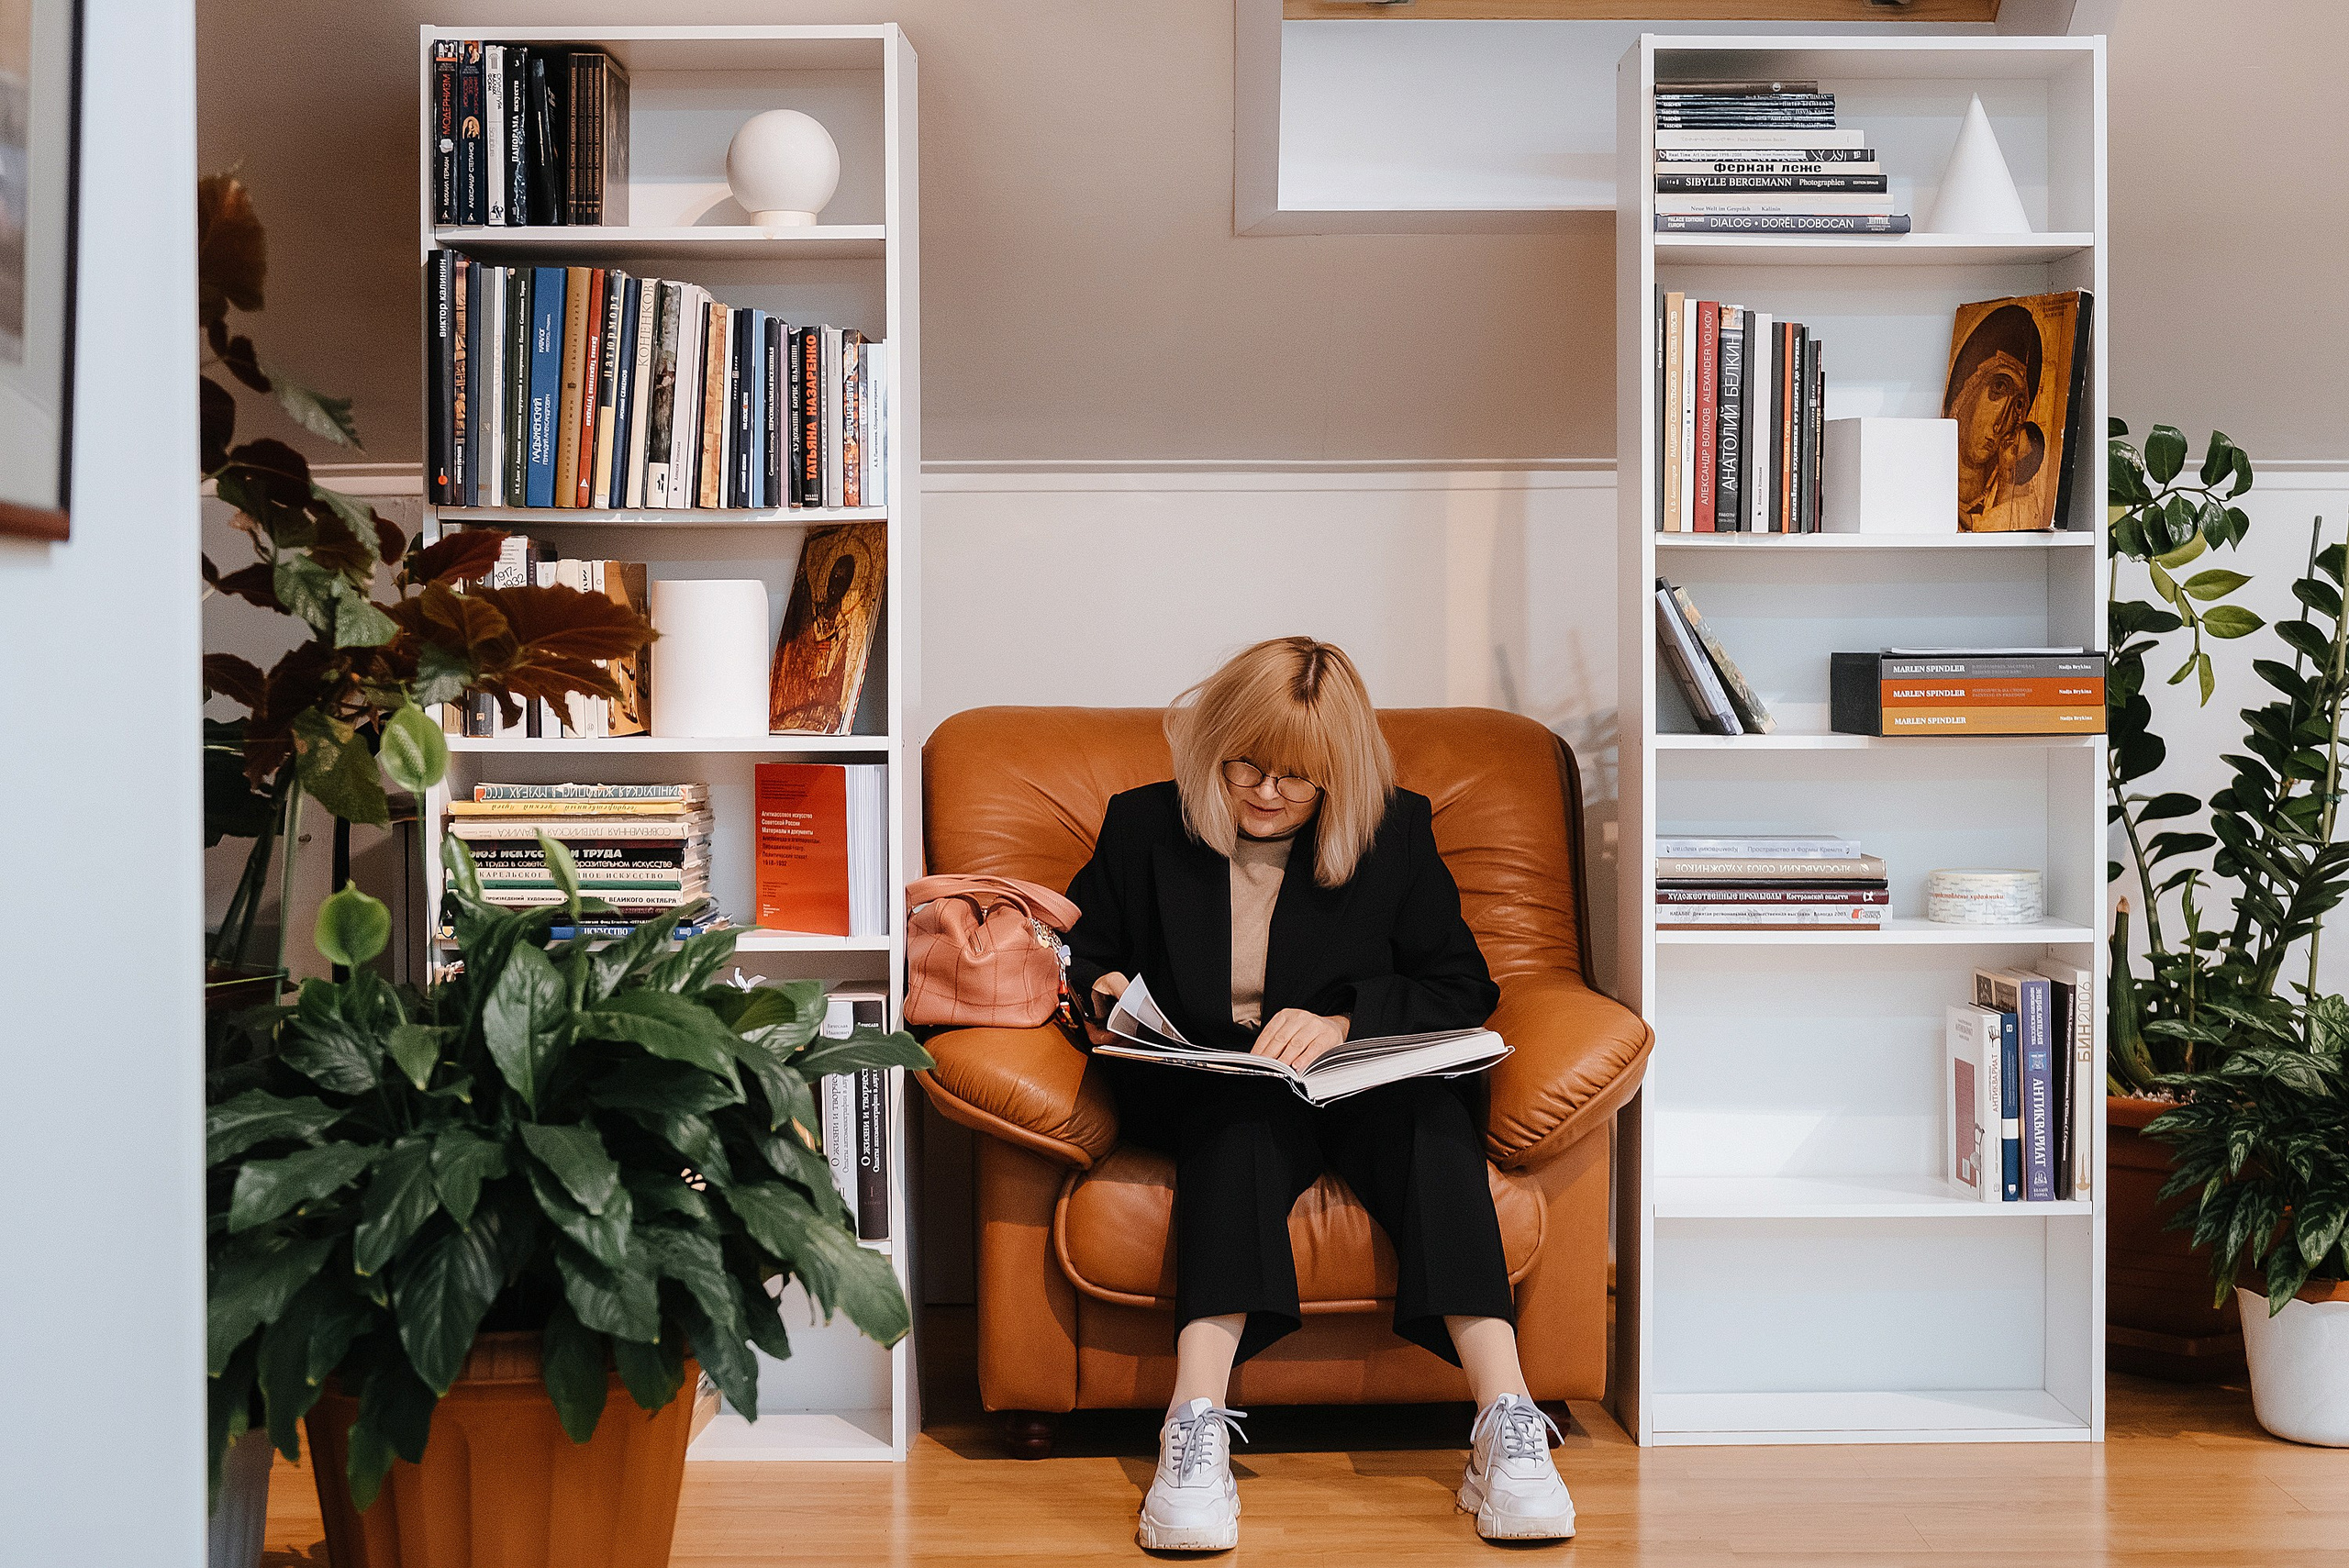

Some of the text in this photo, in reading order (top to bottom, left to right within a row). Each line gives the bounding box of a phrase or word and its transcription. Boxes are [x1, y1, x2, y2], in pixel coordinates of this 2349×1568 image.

[442, 73, 451, 134] МОДЕРНИЗМ
[511, 115, 519, 162] ПАНОРАМА
[1685, 178, 1726, 187] SIBYLLE
[1729, 178, 1792, 187] BERGEMANN
[1799, 179, 1845, 187] Photographien
[1710, 217, 1854, 228] DIALOG DORÉL DOBOCAN
[438, 259, 448, 338] виктор калинин
[638, 285, 654, 367] КОНЕНКОВ
[806, 334, 818, 416] НАЗАРЕНКО
[1720, 334, 1740, 491] АНАТОЛИЙ БЕЛКИН
[532, 398, 542, 463] ЛАДЫЖЕНСКИЙ
[806, 422, 818, 480] ТАТЬЯНА
[1701, 408, 1710, 505] АЛЕКСАНДР ВОЛКОВ
[495, 567, 517, 583] 1917-
[502, 573, 525, 588] 1932
[1893, 665, 1925, 673] MARLEN
[1926, 664, 1965, 673] SPINDLER
[509, 787, 547, 798] МУЗЕЯХ
[547, 828, 671, 838] СОВРЕМЕННАЯ ЛАТВИЙСКАЯ
[583, 850, 622, 858] ТРУДА
[1675, 864, 1850, 874] ЯРОСЛАВСКИЙ СОЮЗ ХУДОЖНИКОВ
[1787, 893, 1824, 901] Костромской
[2077, 982, 2091, 1062] БИН2006
[2033, 1078, 2046, 1167] АНТИКВАРИАТ
[830, 1157, 840, 1167] О
[861, 1156, 871, 1167] О
